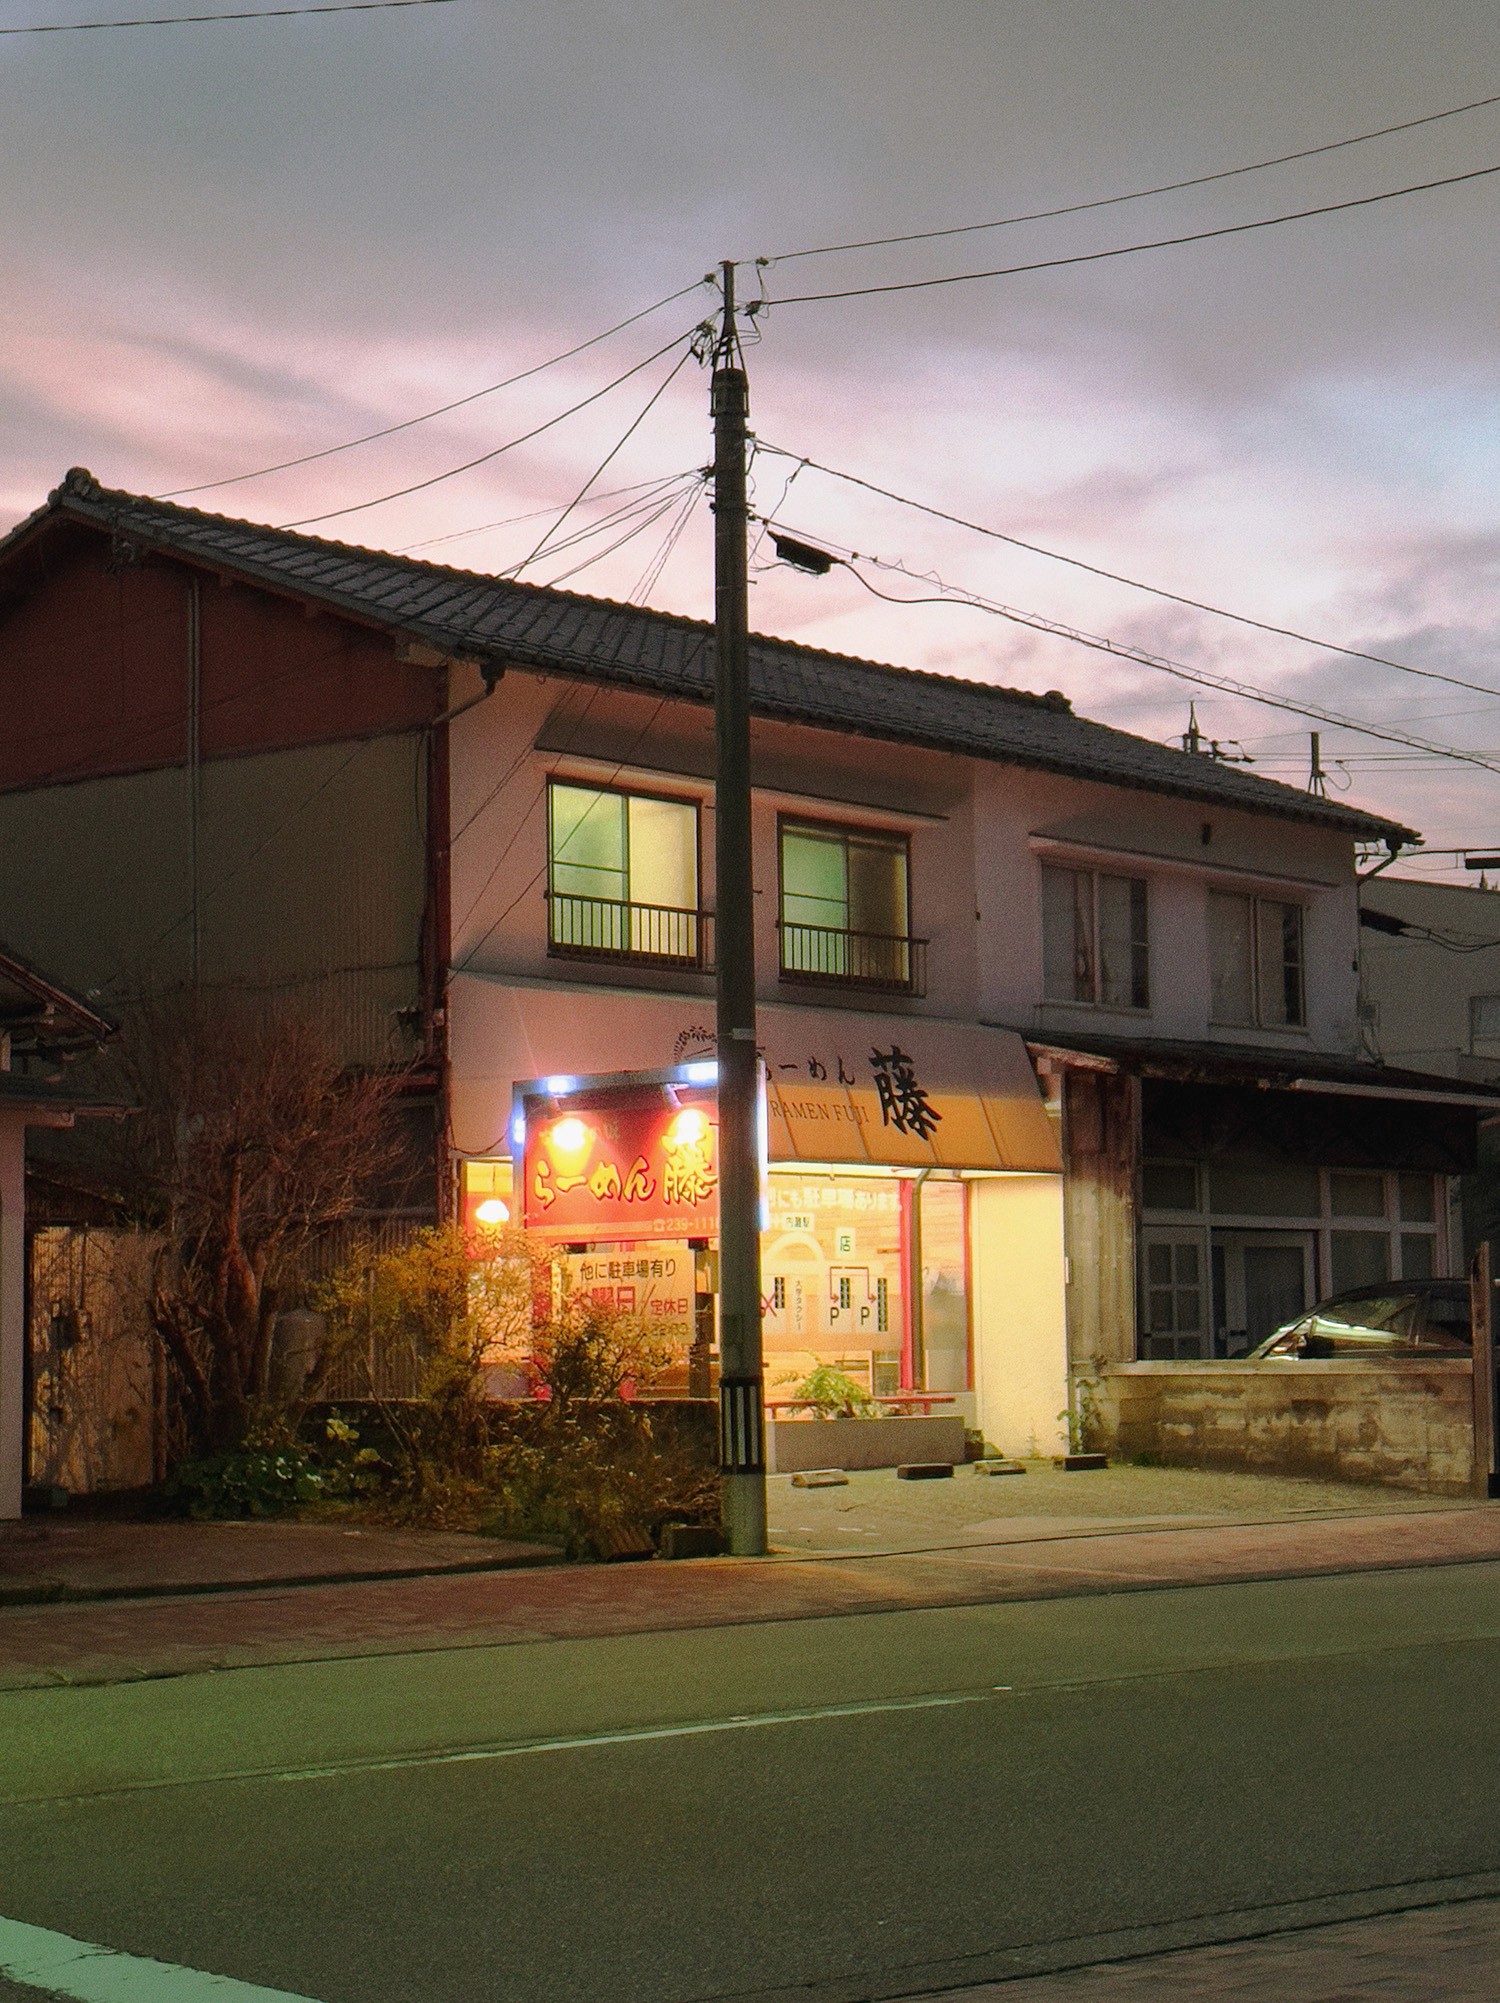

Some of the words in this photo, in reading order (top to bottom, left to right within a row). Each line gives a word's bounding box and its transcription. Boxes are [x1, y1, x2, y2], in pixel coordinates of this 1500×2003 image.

[868, 1044, 943, 1141] 藤
[770, 1100, 830, 1120] RAMEN
[832, 1105, 870, 1125] FUJI
[534, 1155, 657, 1210] らーめん
[579, 1258, 677, 1281] 他に駐車場有り
[650, 1298, 689, 1316] 定休日
[830, 1306, 840, 1326] P
[860, 1306, 870, 1326] P
